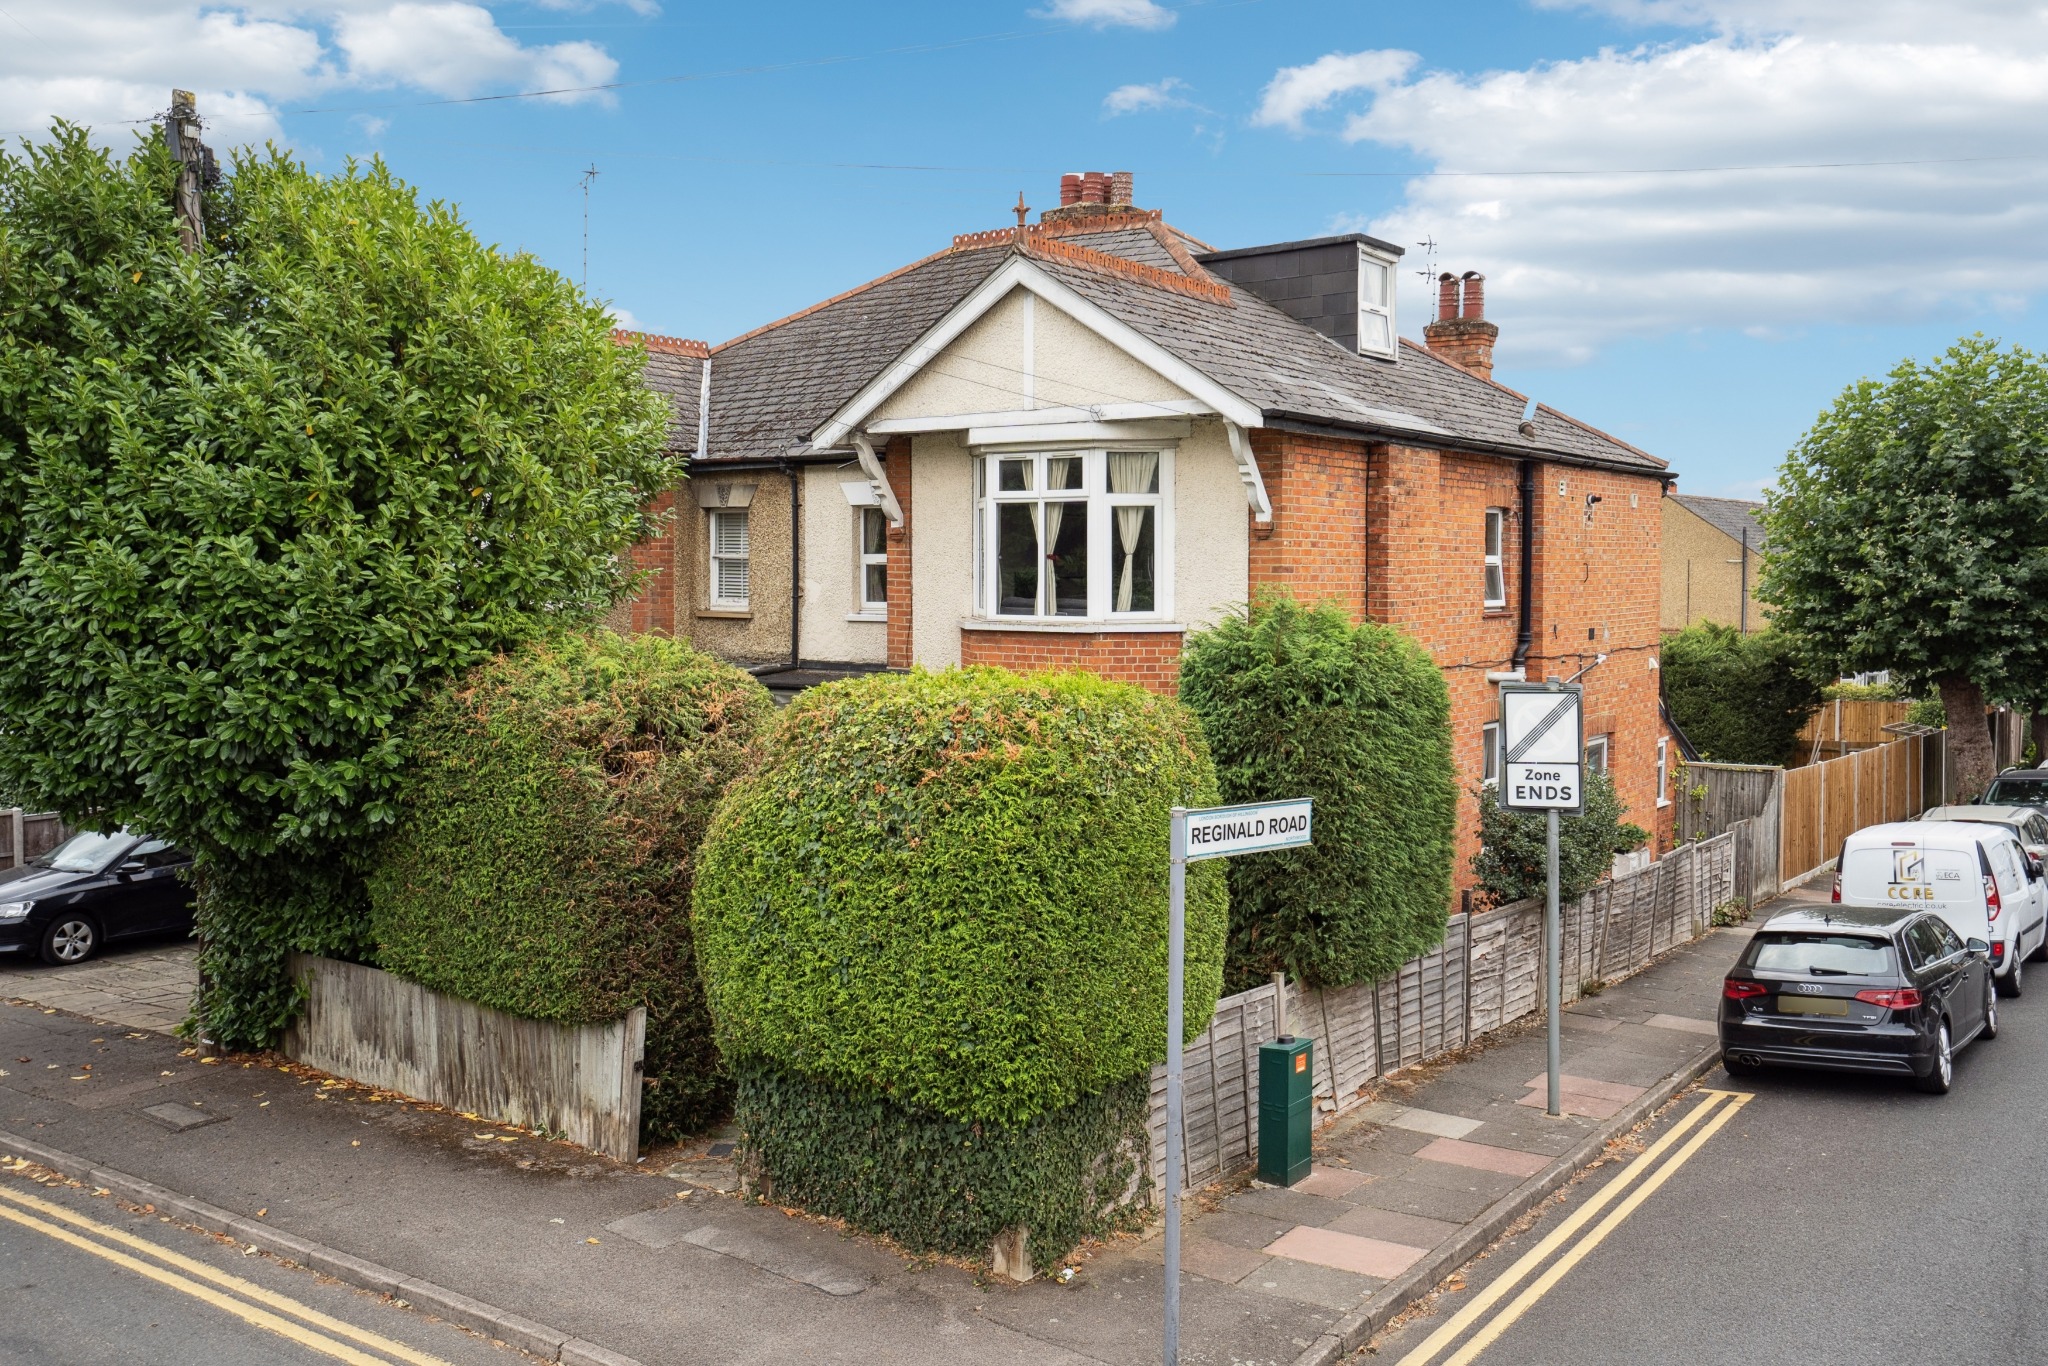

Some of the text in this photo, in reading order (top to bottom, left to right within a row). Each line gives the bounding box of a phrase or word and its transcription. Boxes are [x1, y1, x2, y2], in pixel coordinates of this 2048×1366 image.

[1525, 768, 1561, 781] Zone
[1516, 785, 1572, 801] ENDS
[1191, 815, 1307, 845] REGINALD ROAD
[1944, 871, 1960, 879] ECA
